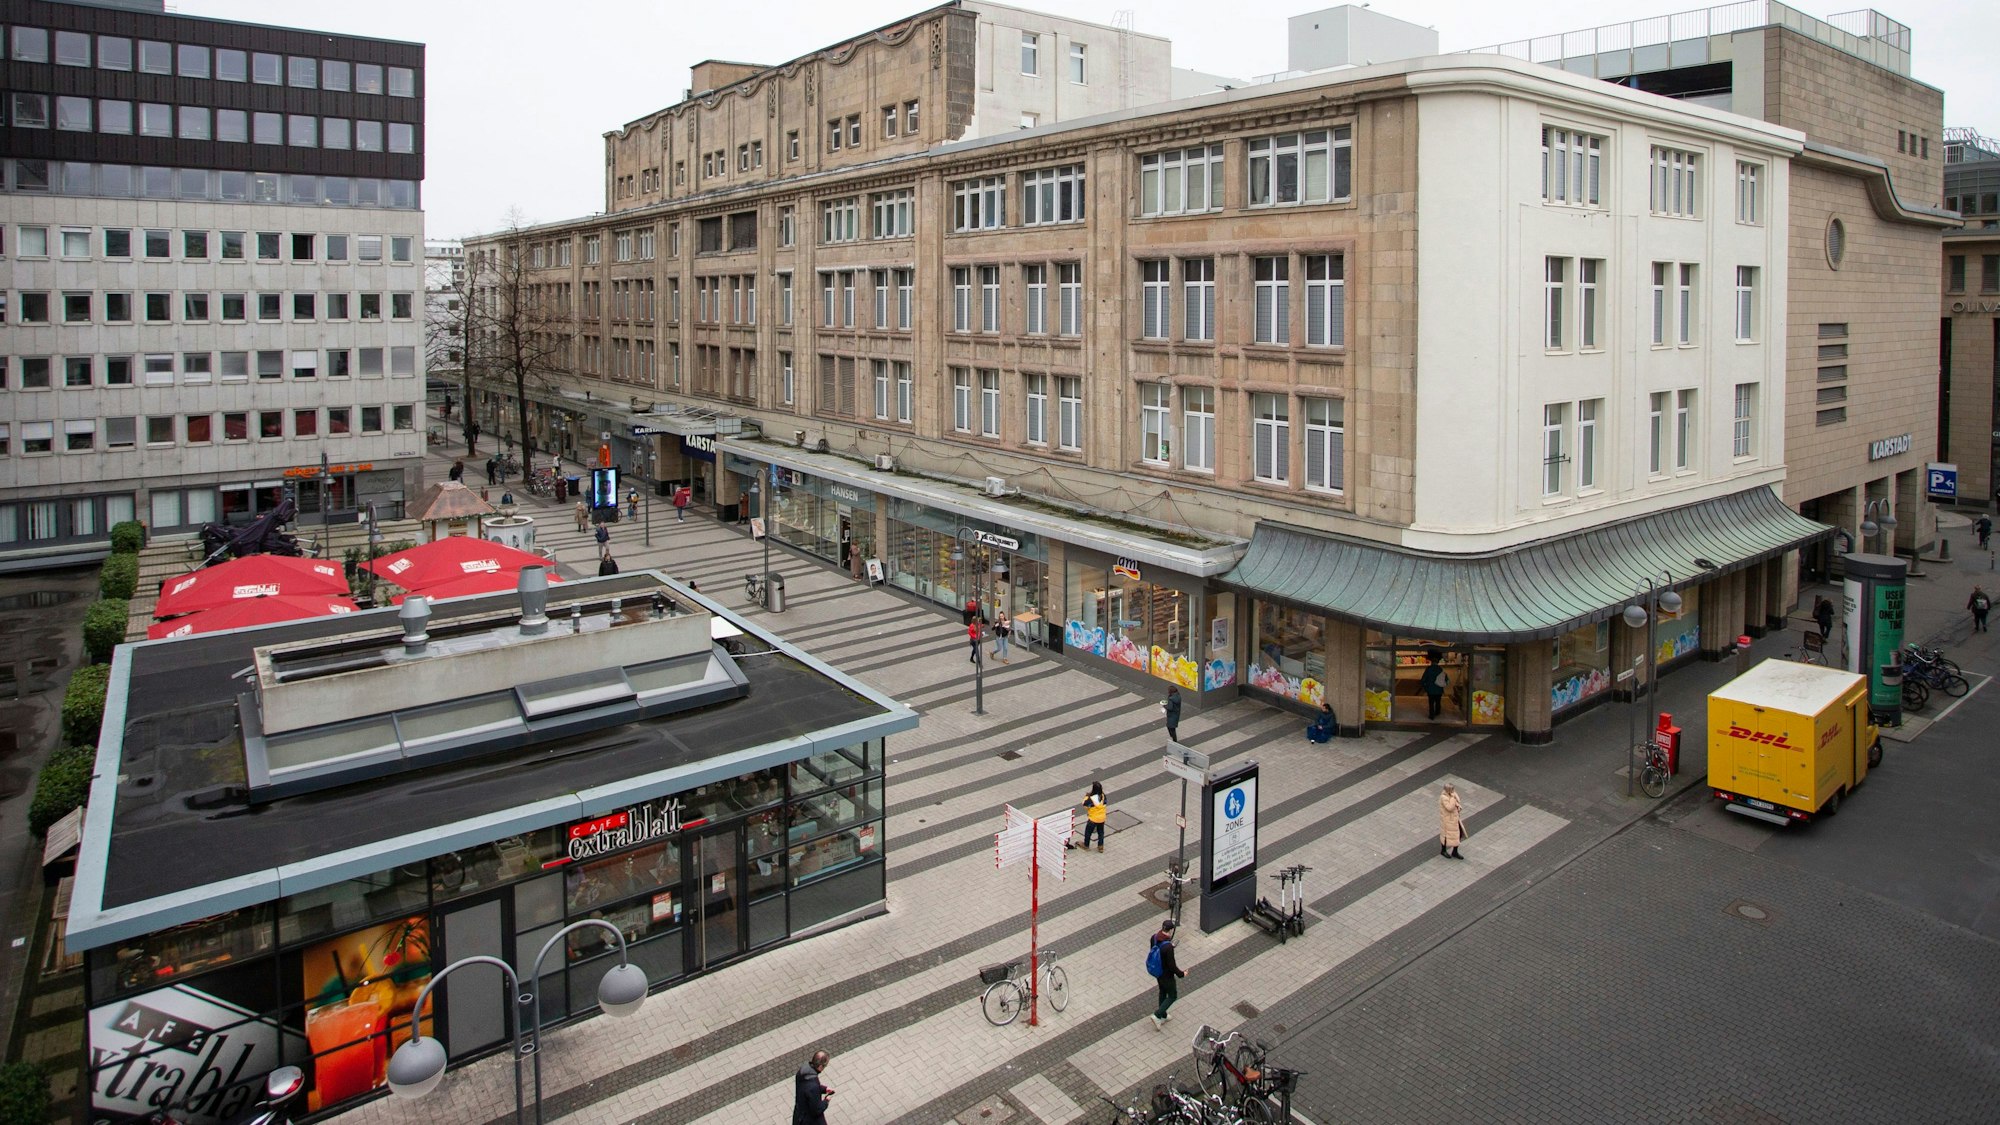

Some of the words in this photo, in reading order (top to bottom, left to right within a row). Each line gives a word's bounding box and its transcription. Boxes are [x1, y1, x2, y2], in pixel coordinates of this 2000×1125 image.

[1872, 433, 1912, 460] KARSTADT
[1930, 473, 1945, 487] P
[831, 484, 859, 501] HANSEN
[1729, 726, 1791, 749] DHL
[1821, 723, 1840, 746] DHL
[568, 798, 686, 861] extrablatt
[572, 815, 626, 836] CAFE
[1225, 817, 1244, 832] ZONE
